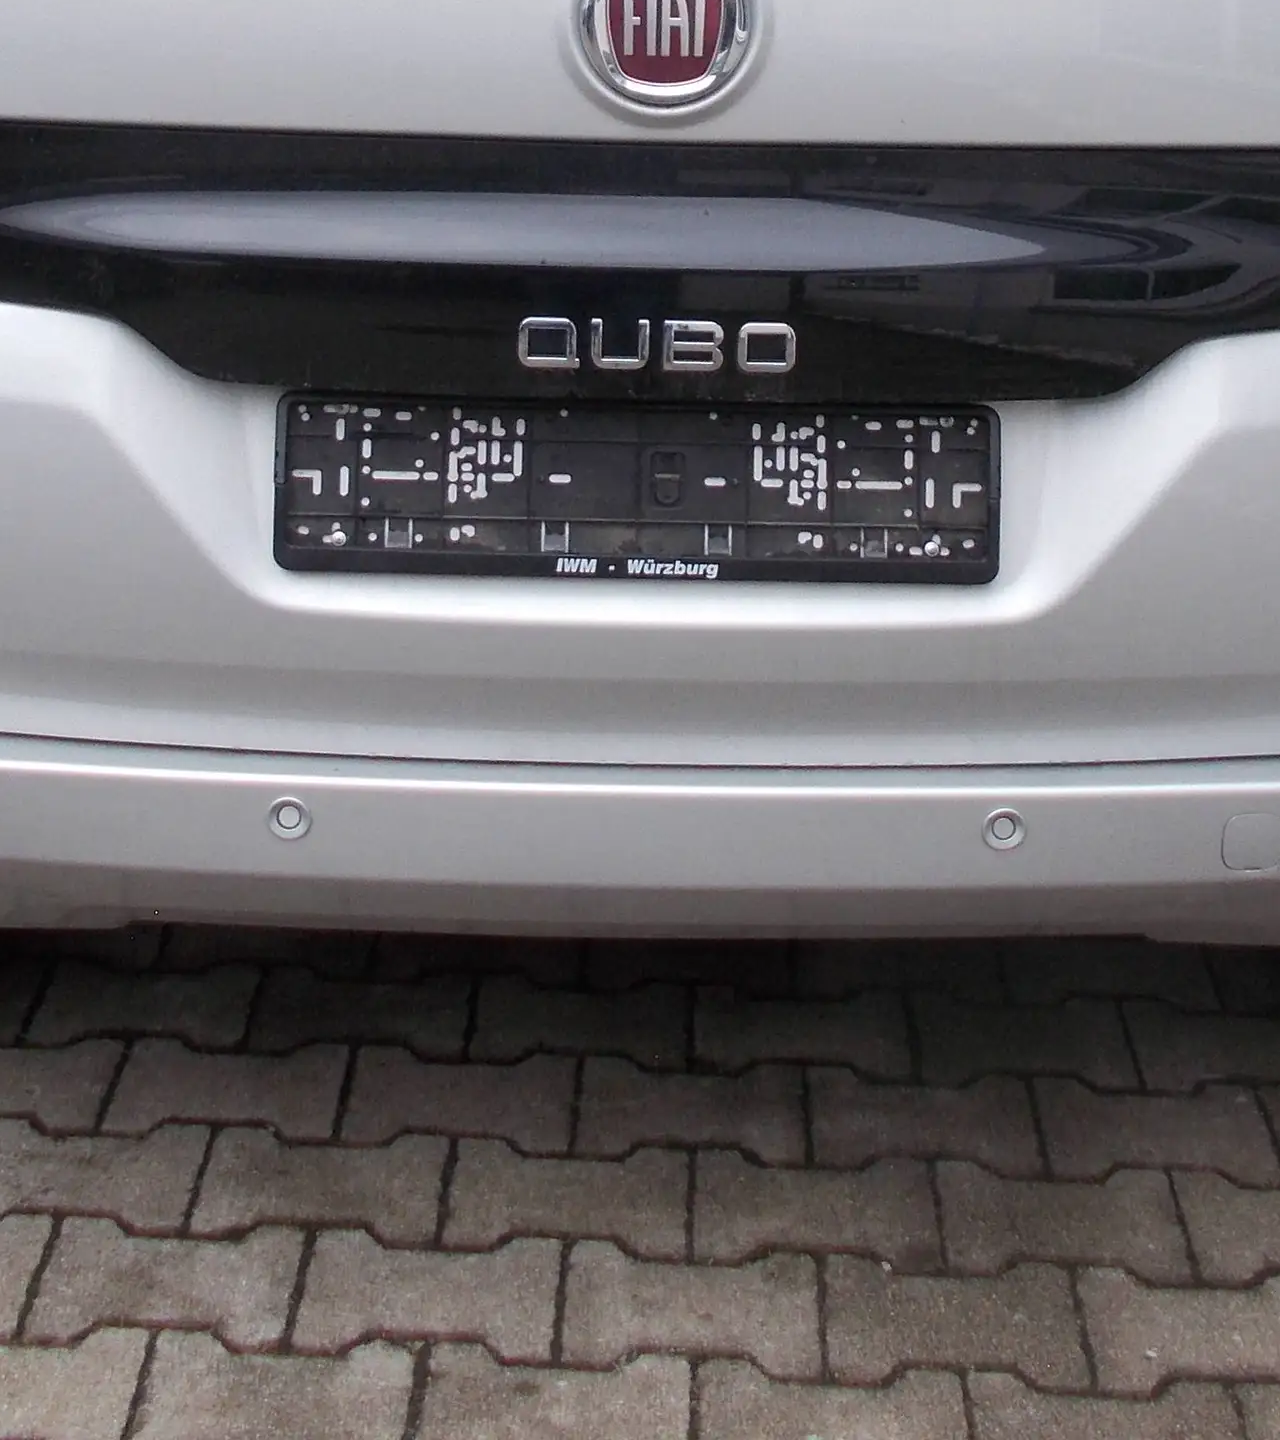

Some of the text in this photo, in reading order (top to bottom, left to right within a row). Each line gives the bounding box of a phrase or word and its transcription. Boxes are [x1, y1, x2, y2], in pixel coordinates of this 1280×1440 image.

[518, 317, 796, 373] QUBO
[556, 558, 597, 574] IWM
[627, 559, 719, 579] Würzburg
